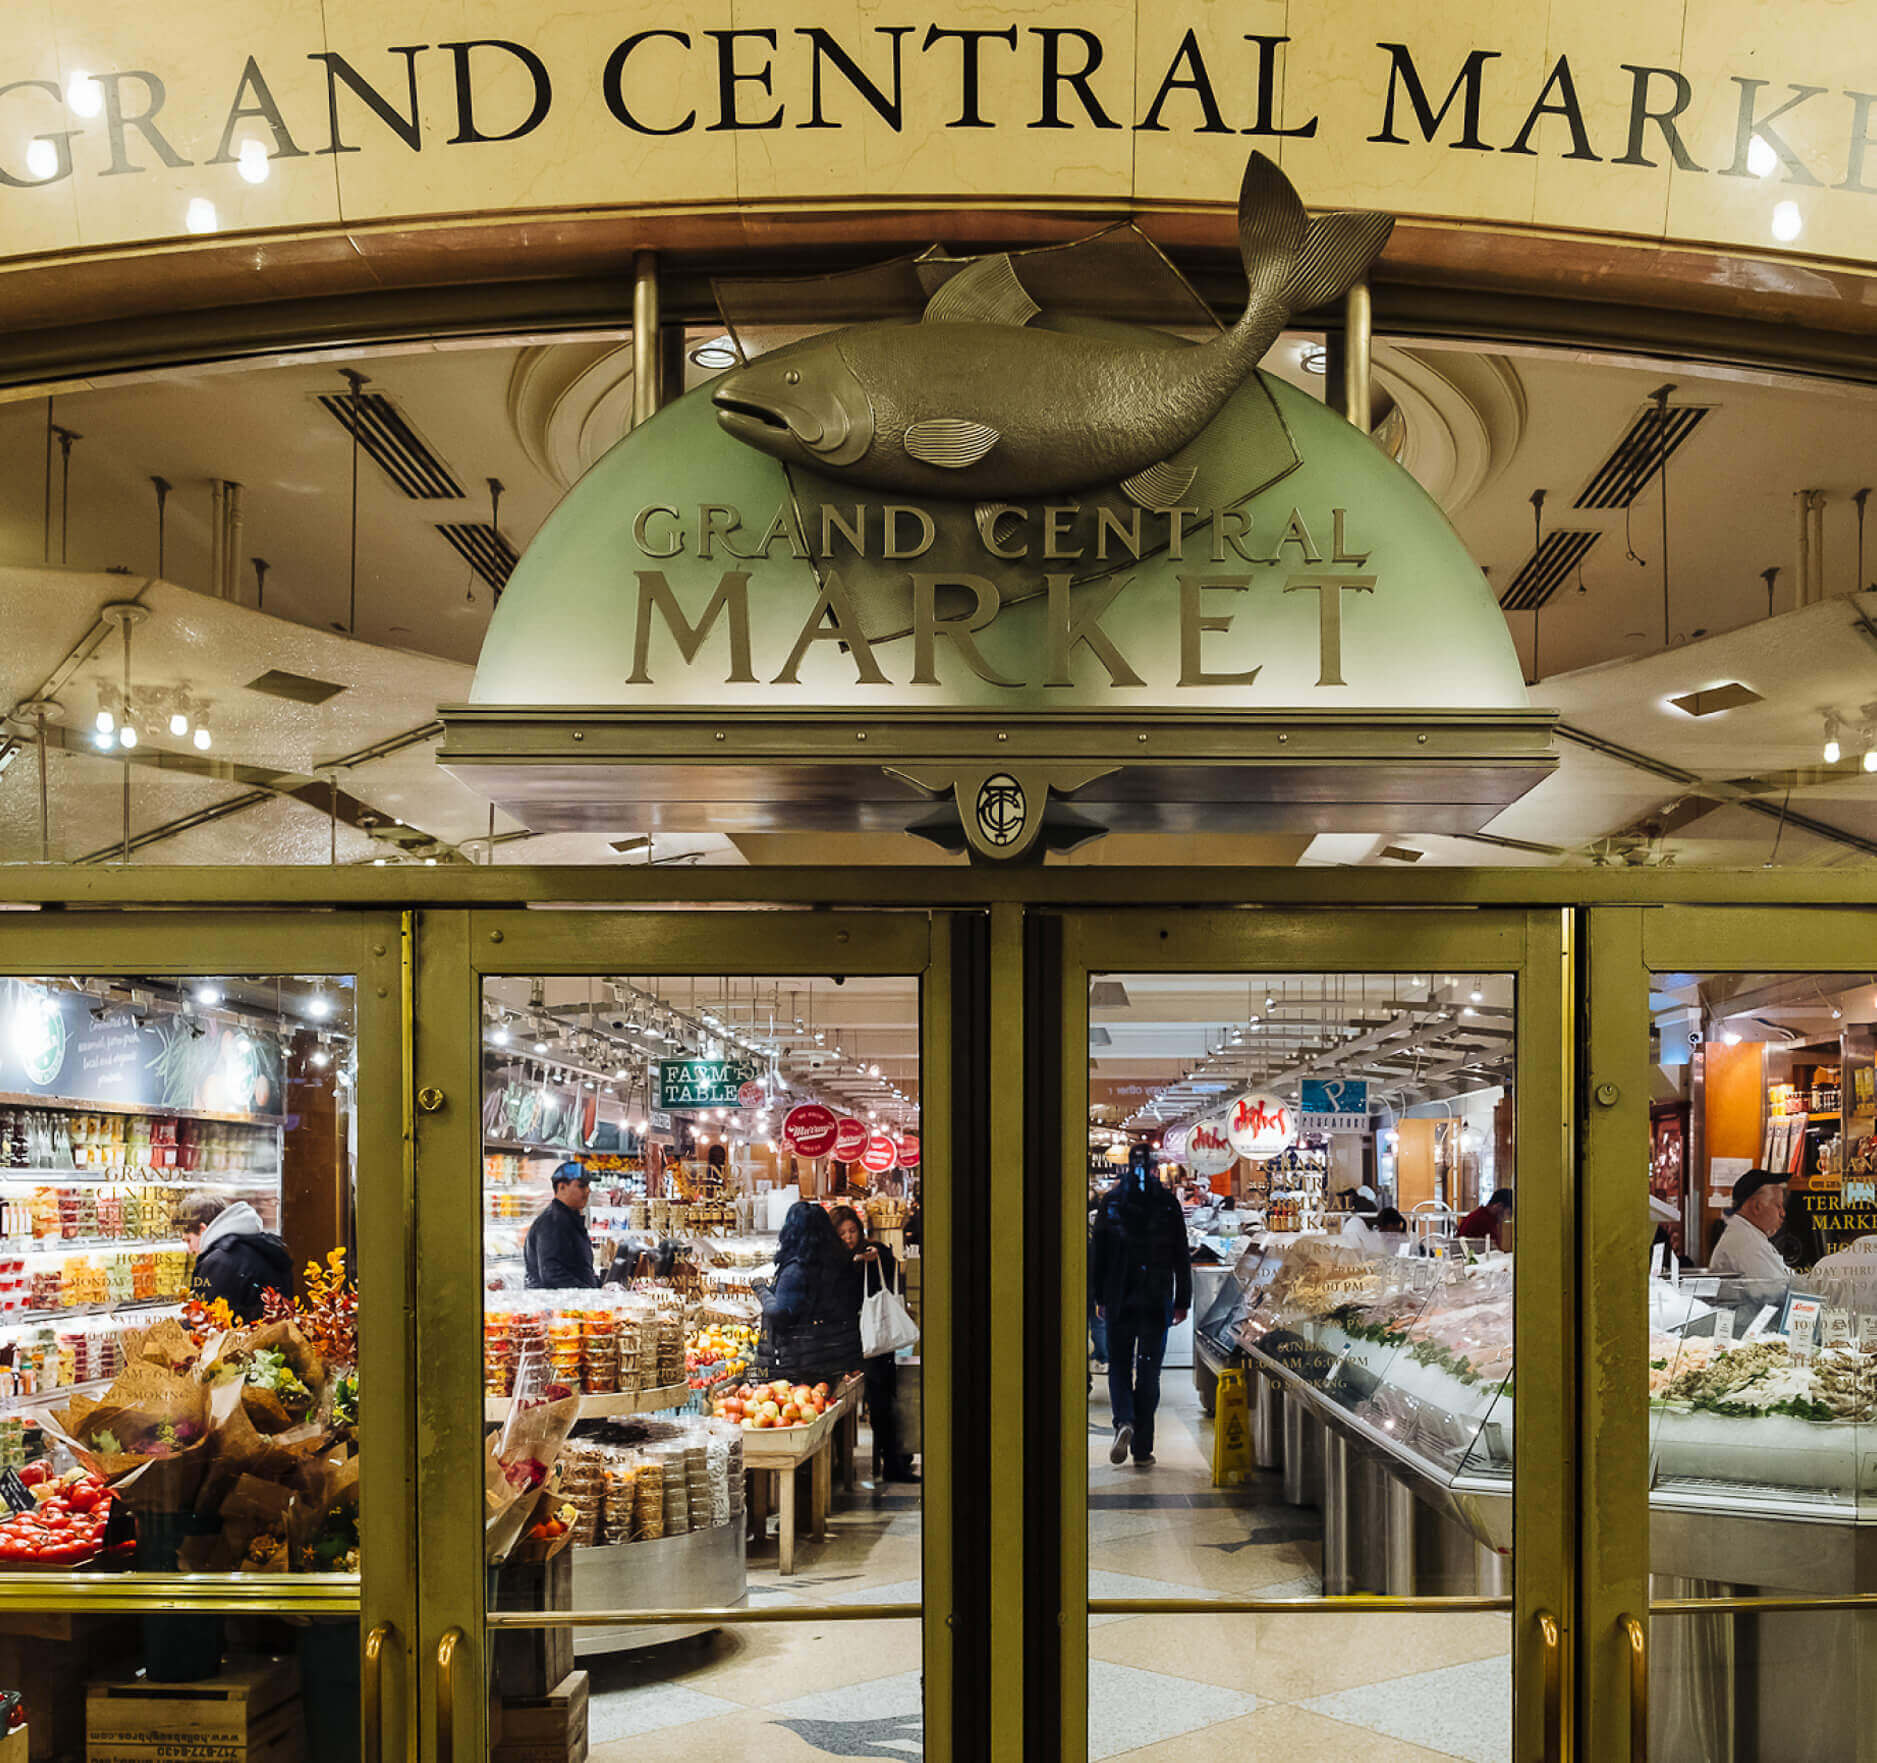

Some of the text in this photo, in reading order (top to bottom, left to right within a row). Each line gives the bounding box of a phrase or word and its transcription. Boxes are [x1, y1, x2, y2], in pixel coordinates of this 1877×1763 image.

[0, 39, 552, 188] GRAND
[602, 23, 1318, 137] CENTRAL
[632, 503, 1372, 566] GRAND CENTRAL
[625, 569, 1379, 687] MARKET
[665, 1065, 730, 1083] FARM
[665, 1085, 738, 1102] TABLE
[1234, 1100, 1286, 1138] dishes
